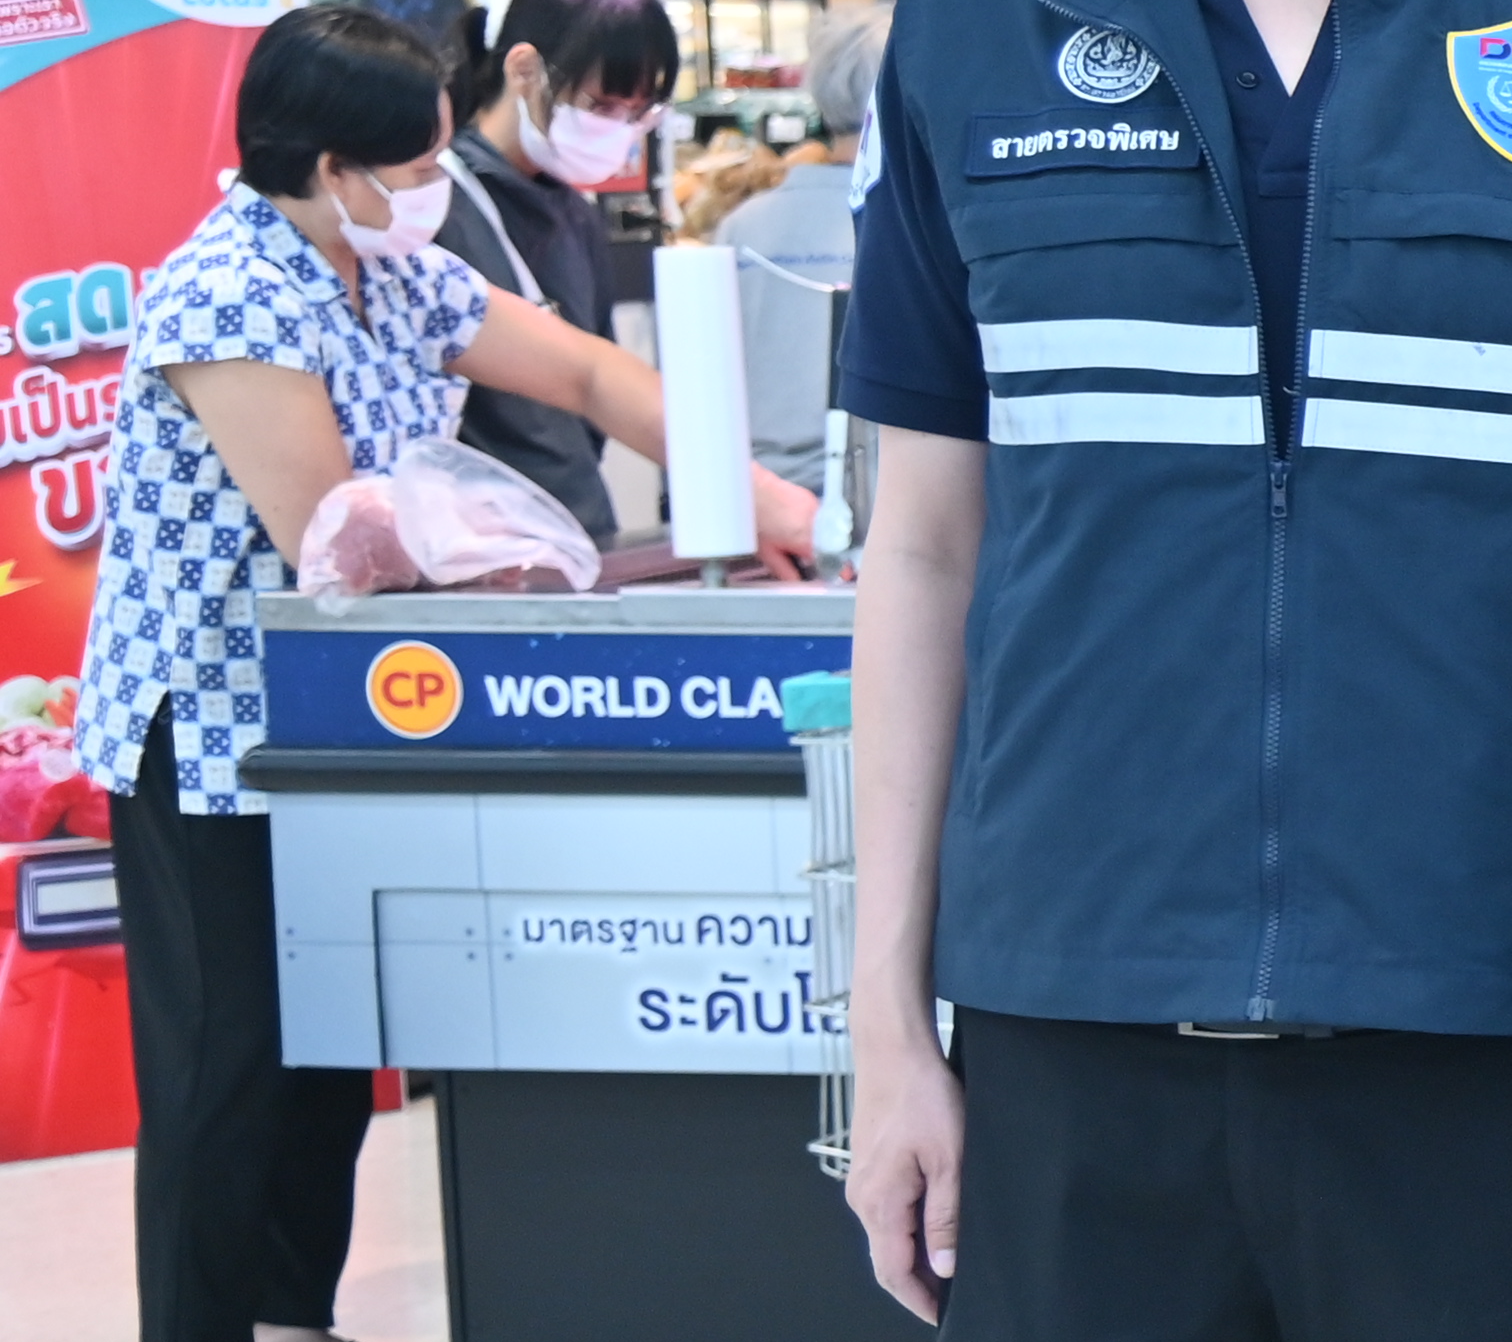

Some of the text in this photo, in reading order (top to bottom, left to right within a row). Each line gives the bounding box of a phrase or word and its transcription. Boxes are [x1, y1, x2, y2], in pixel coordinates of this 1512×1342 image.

[991, 122, 1180, 160] สายตรวจพิเศษ
[381, 671, 445, 709] CP
[484, 674, 784, 719] WORLD CLA
[523, 917, 685, 952] มาตรฐาน
